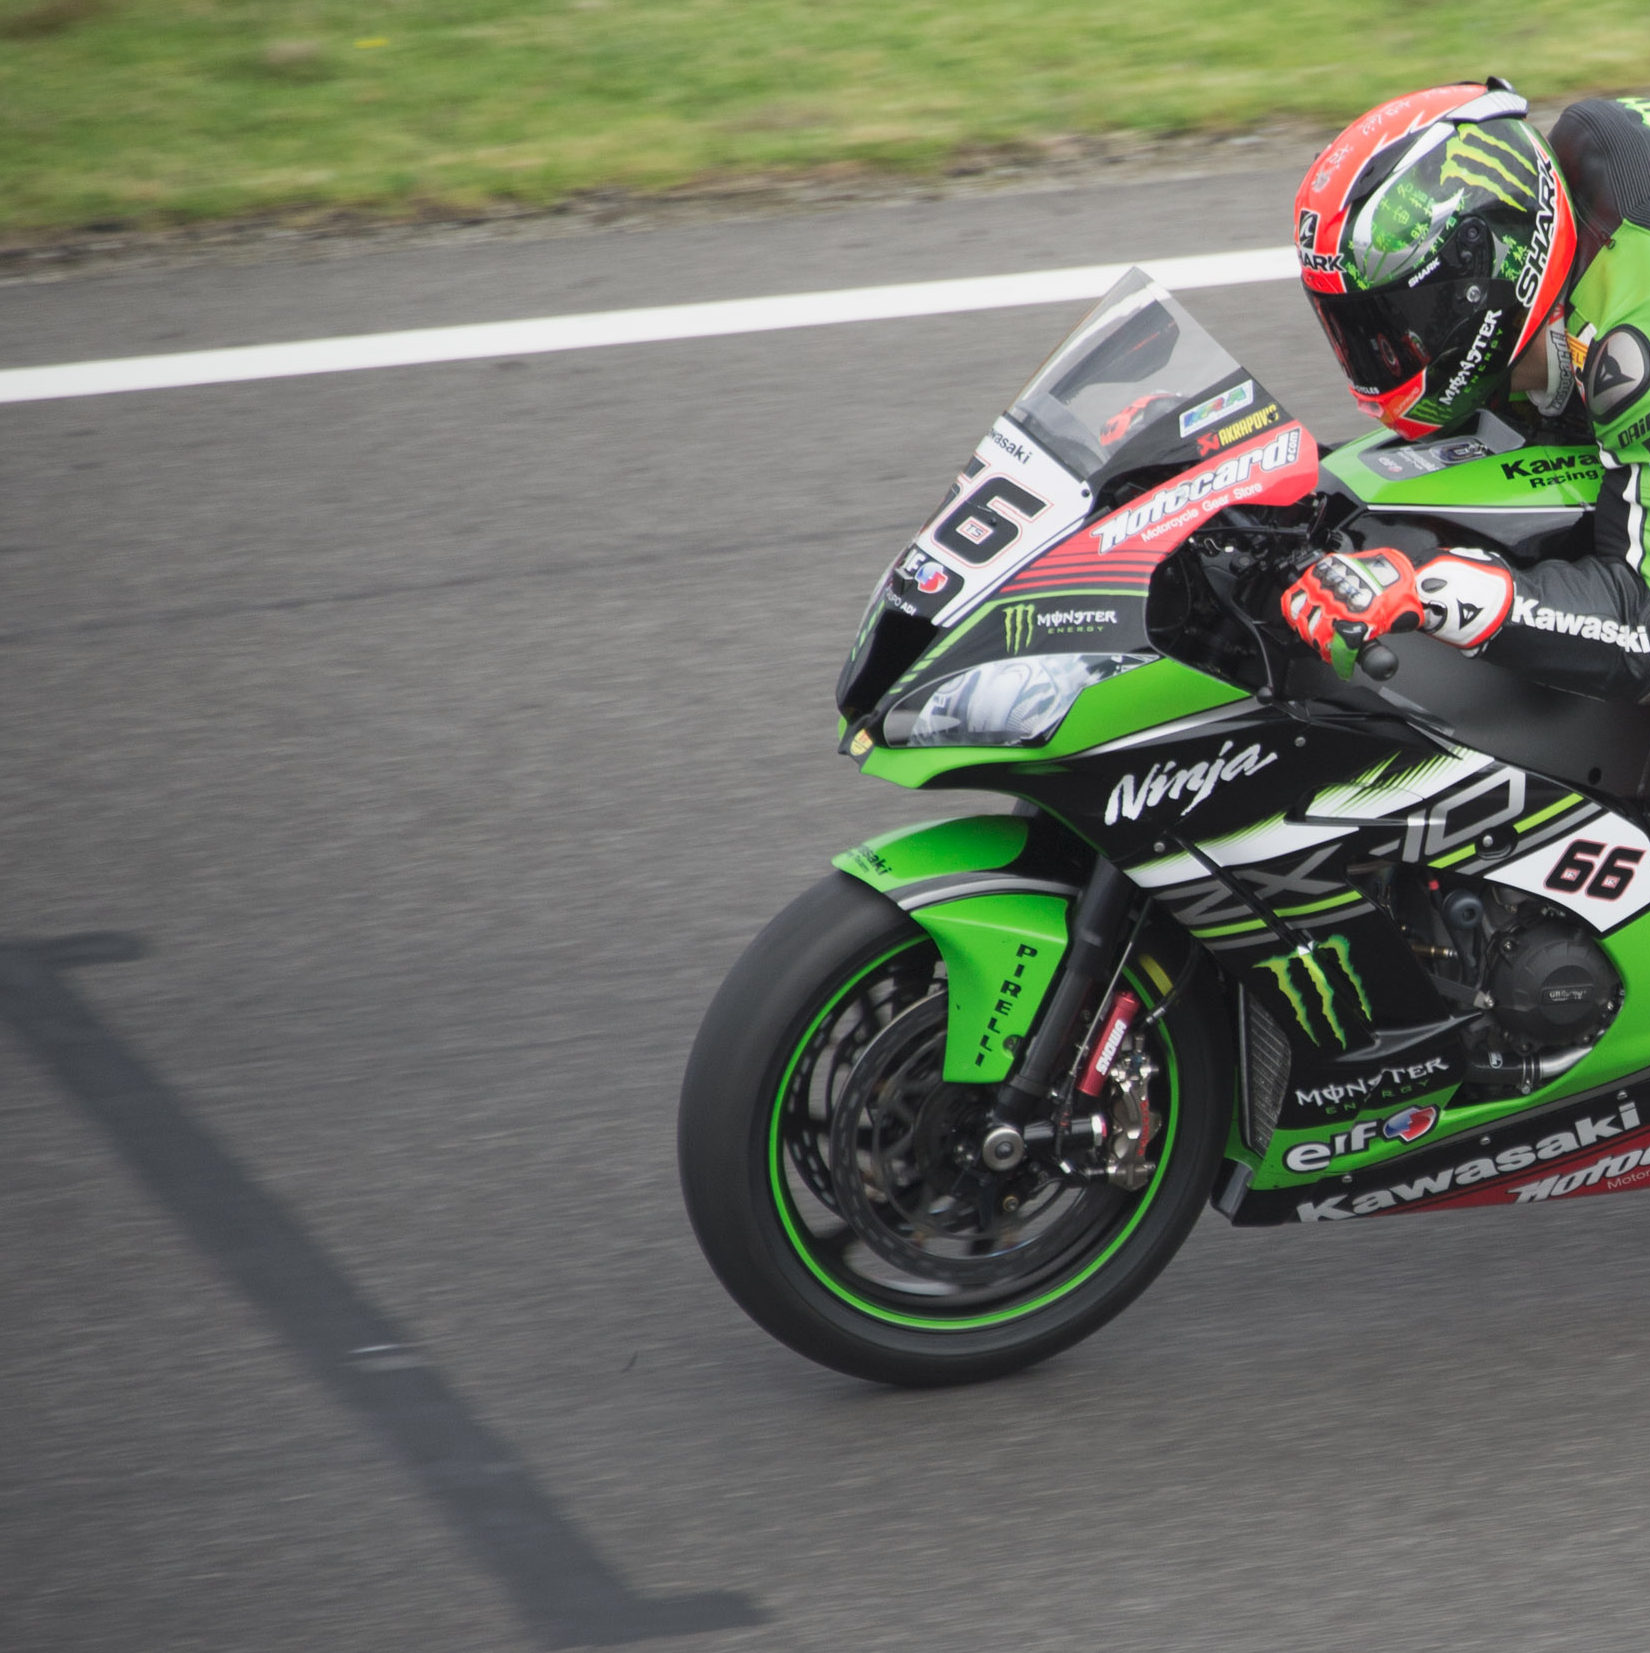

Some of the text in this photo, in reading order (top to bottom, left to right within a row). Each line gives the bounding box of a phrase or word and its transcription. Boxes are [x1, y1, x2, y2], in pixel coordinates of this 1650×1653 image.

[1299, 252, 1345, 271] ARK
[1408, 256, 1440, 287] SHARK
[1501, 454, 1600, 480] Kawa
[1233, 482, 1263, 499] Store
[1037, 610, 1118, 628] MONSTER
[1104, 739, 1278, 826] Ninja
[1543, 838, 1647, 902] 66
[975, 943, 1038, 1067] PIRELLI
[1095, 1018, 1127, 1076] SHOWA
[1326, 1079, 1430, 1115] ENRGY
[1296, 1101, 1641, 1224] Kawasaki
